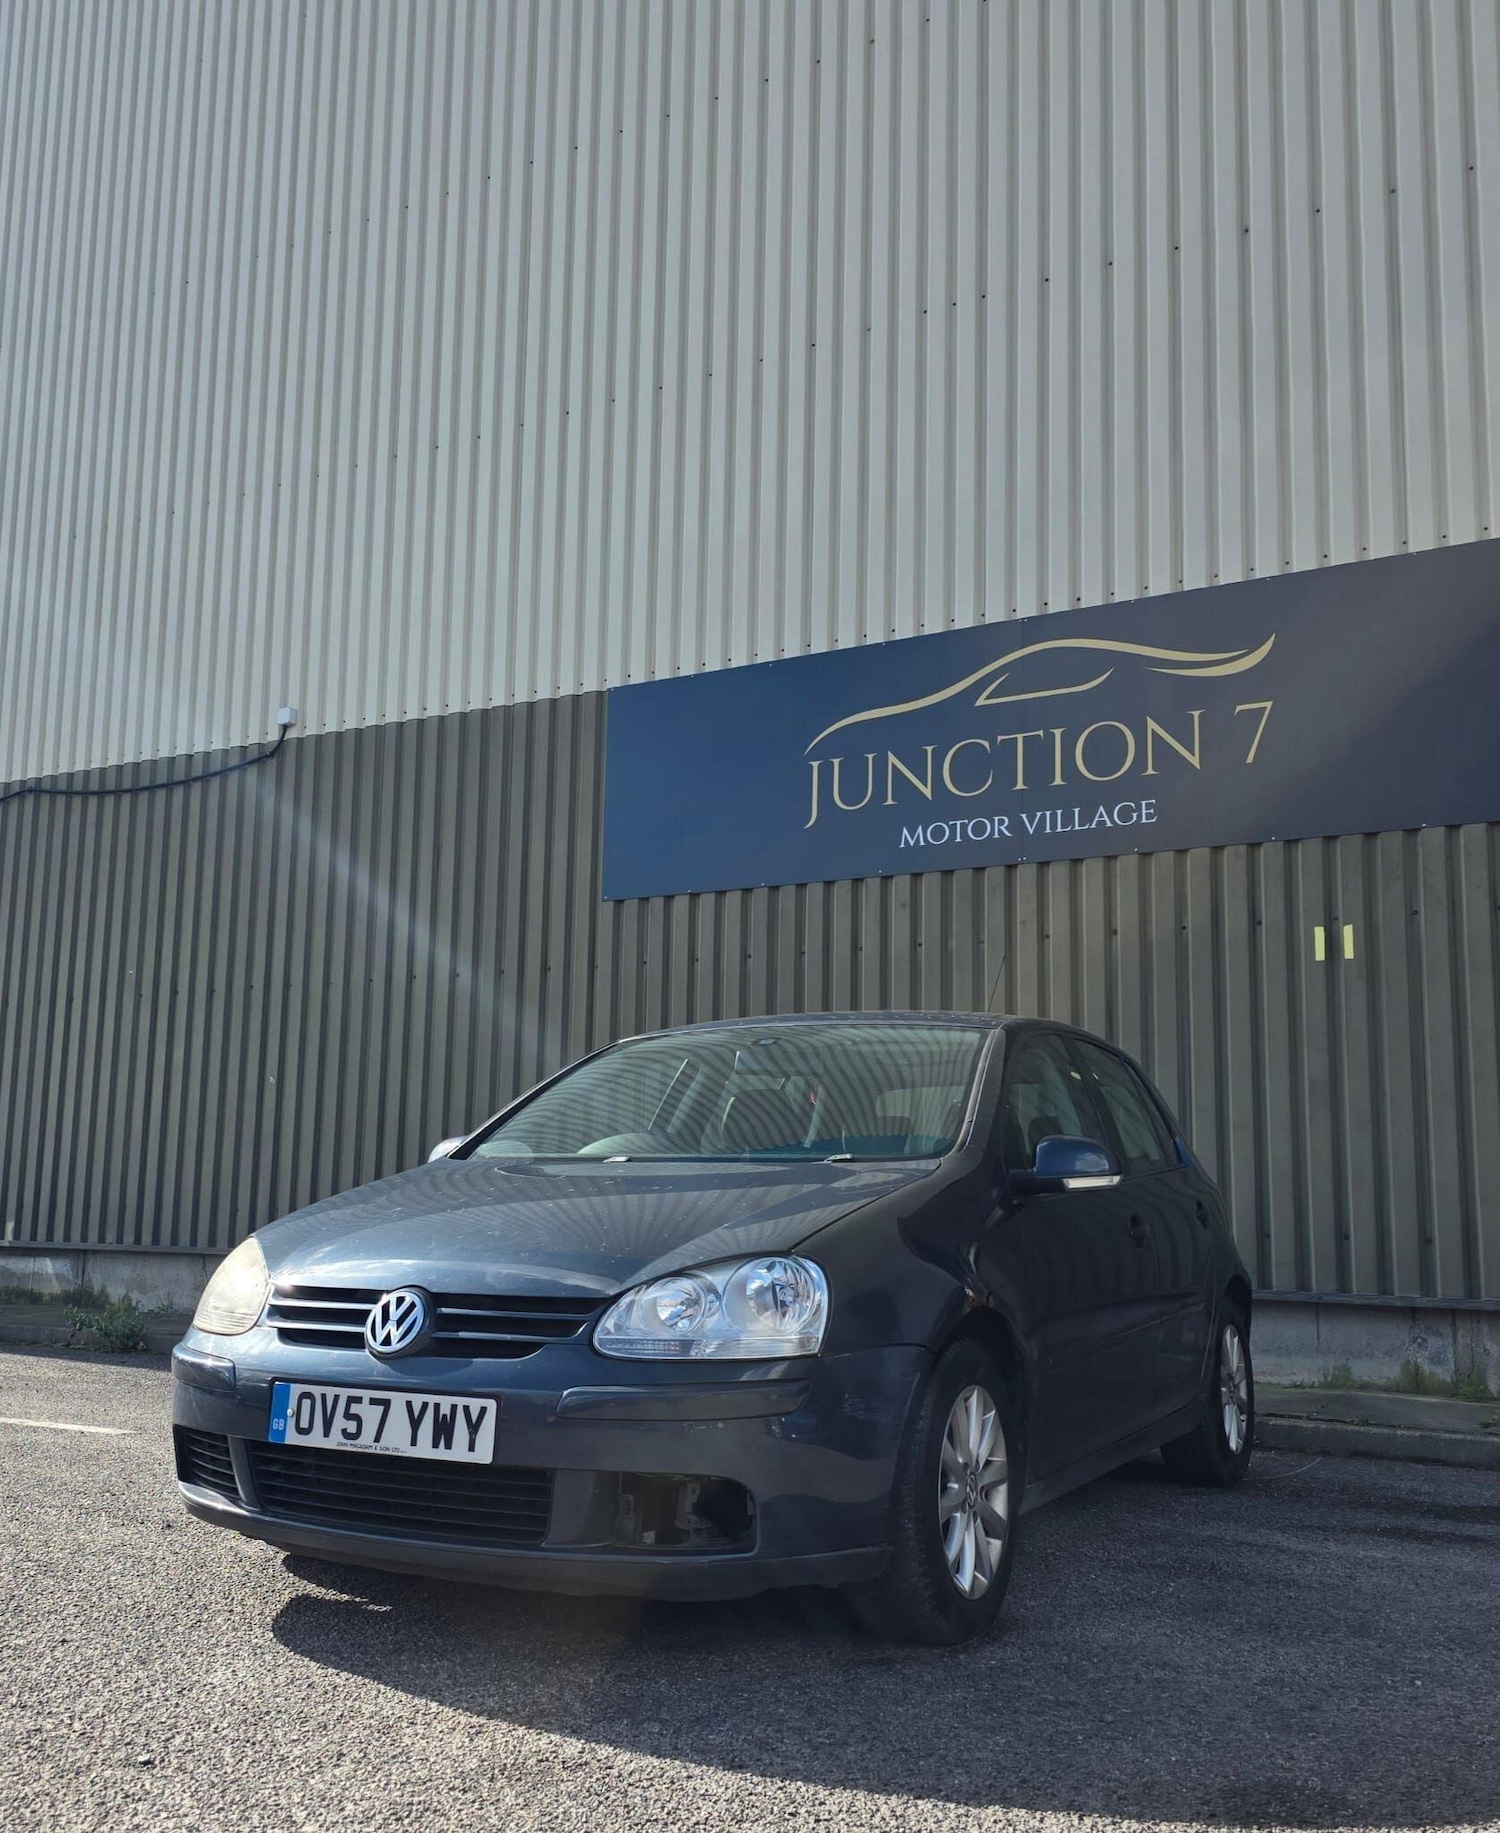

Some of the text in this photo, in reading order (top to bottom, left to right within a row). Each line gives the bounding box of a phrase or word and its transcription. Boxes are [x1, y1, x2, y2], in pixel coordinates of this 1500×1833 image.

[804, 701, 1274, 829] JUNCTION 7
[899, 800, 1158, 849] MOTOR VILLAGE
[272, 1418, 285, 1430] GB
[295, 1391, 488, 1452] OV57 YWY
